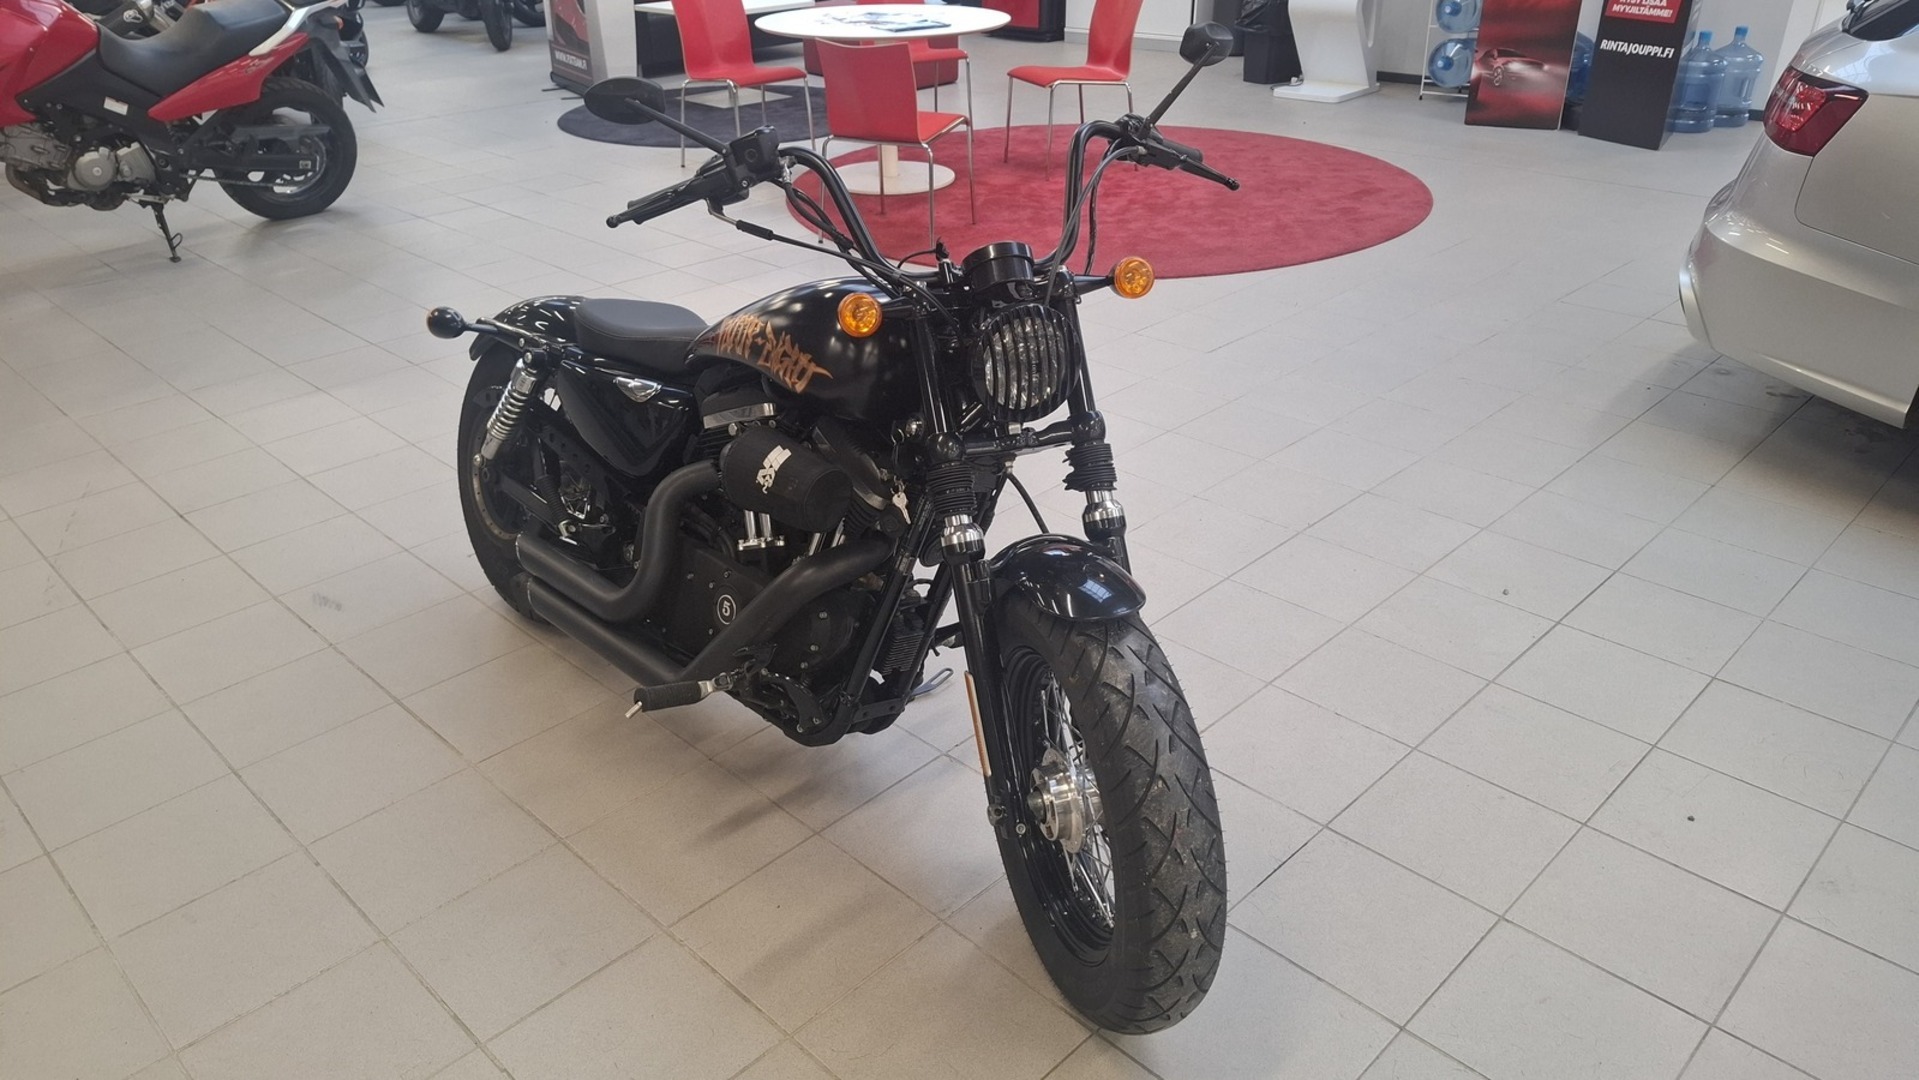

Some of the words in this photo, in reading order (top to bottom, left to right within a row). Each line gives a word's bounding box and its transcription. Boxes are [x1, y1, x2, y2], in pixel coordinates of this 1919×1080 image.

[1612, 4, 1673, 18] MYYJILTÄMME!
[1600, 39, 1675, 59] RINTAJOUPPI.FI
[722, 600, 731, 617] 5
